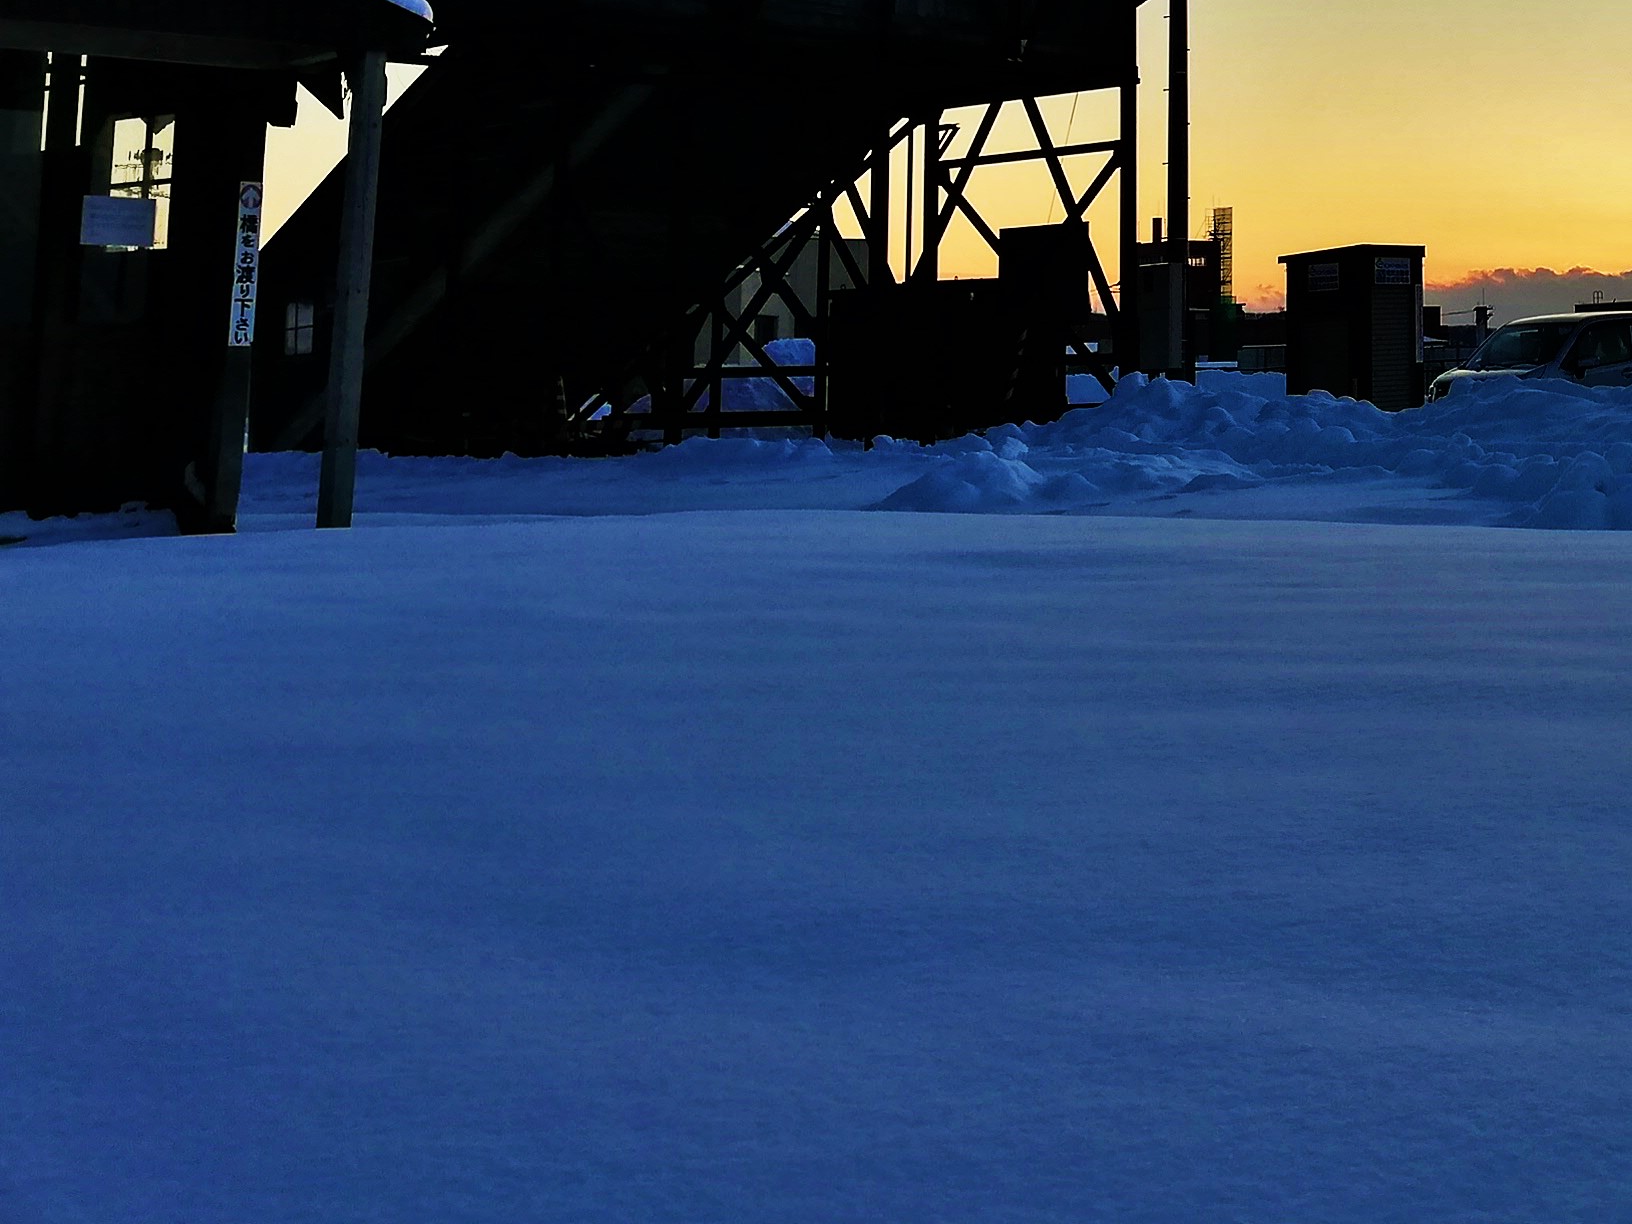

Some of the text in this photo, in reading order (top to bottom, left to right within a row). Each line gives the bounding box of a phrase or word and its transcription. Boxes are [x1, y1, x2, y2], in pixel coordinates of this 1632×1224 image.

[234, 214, 258, 344] 橋をお渡り下さい
